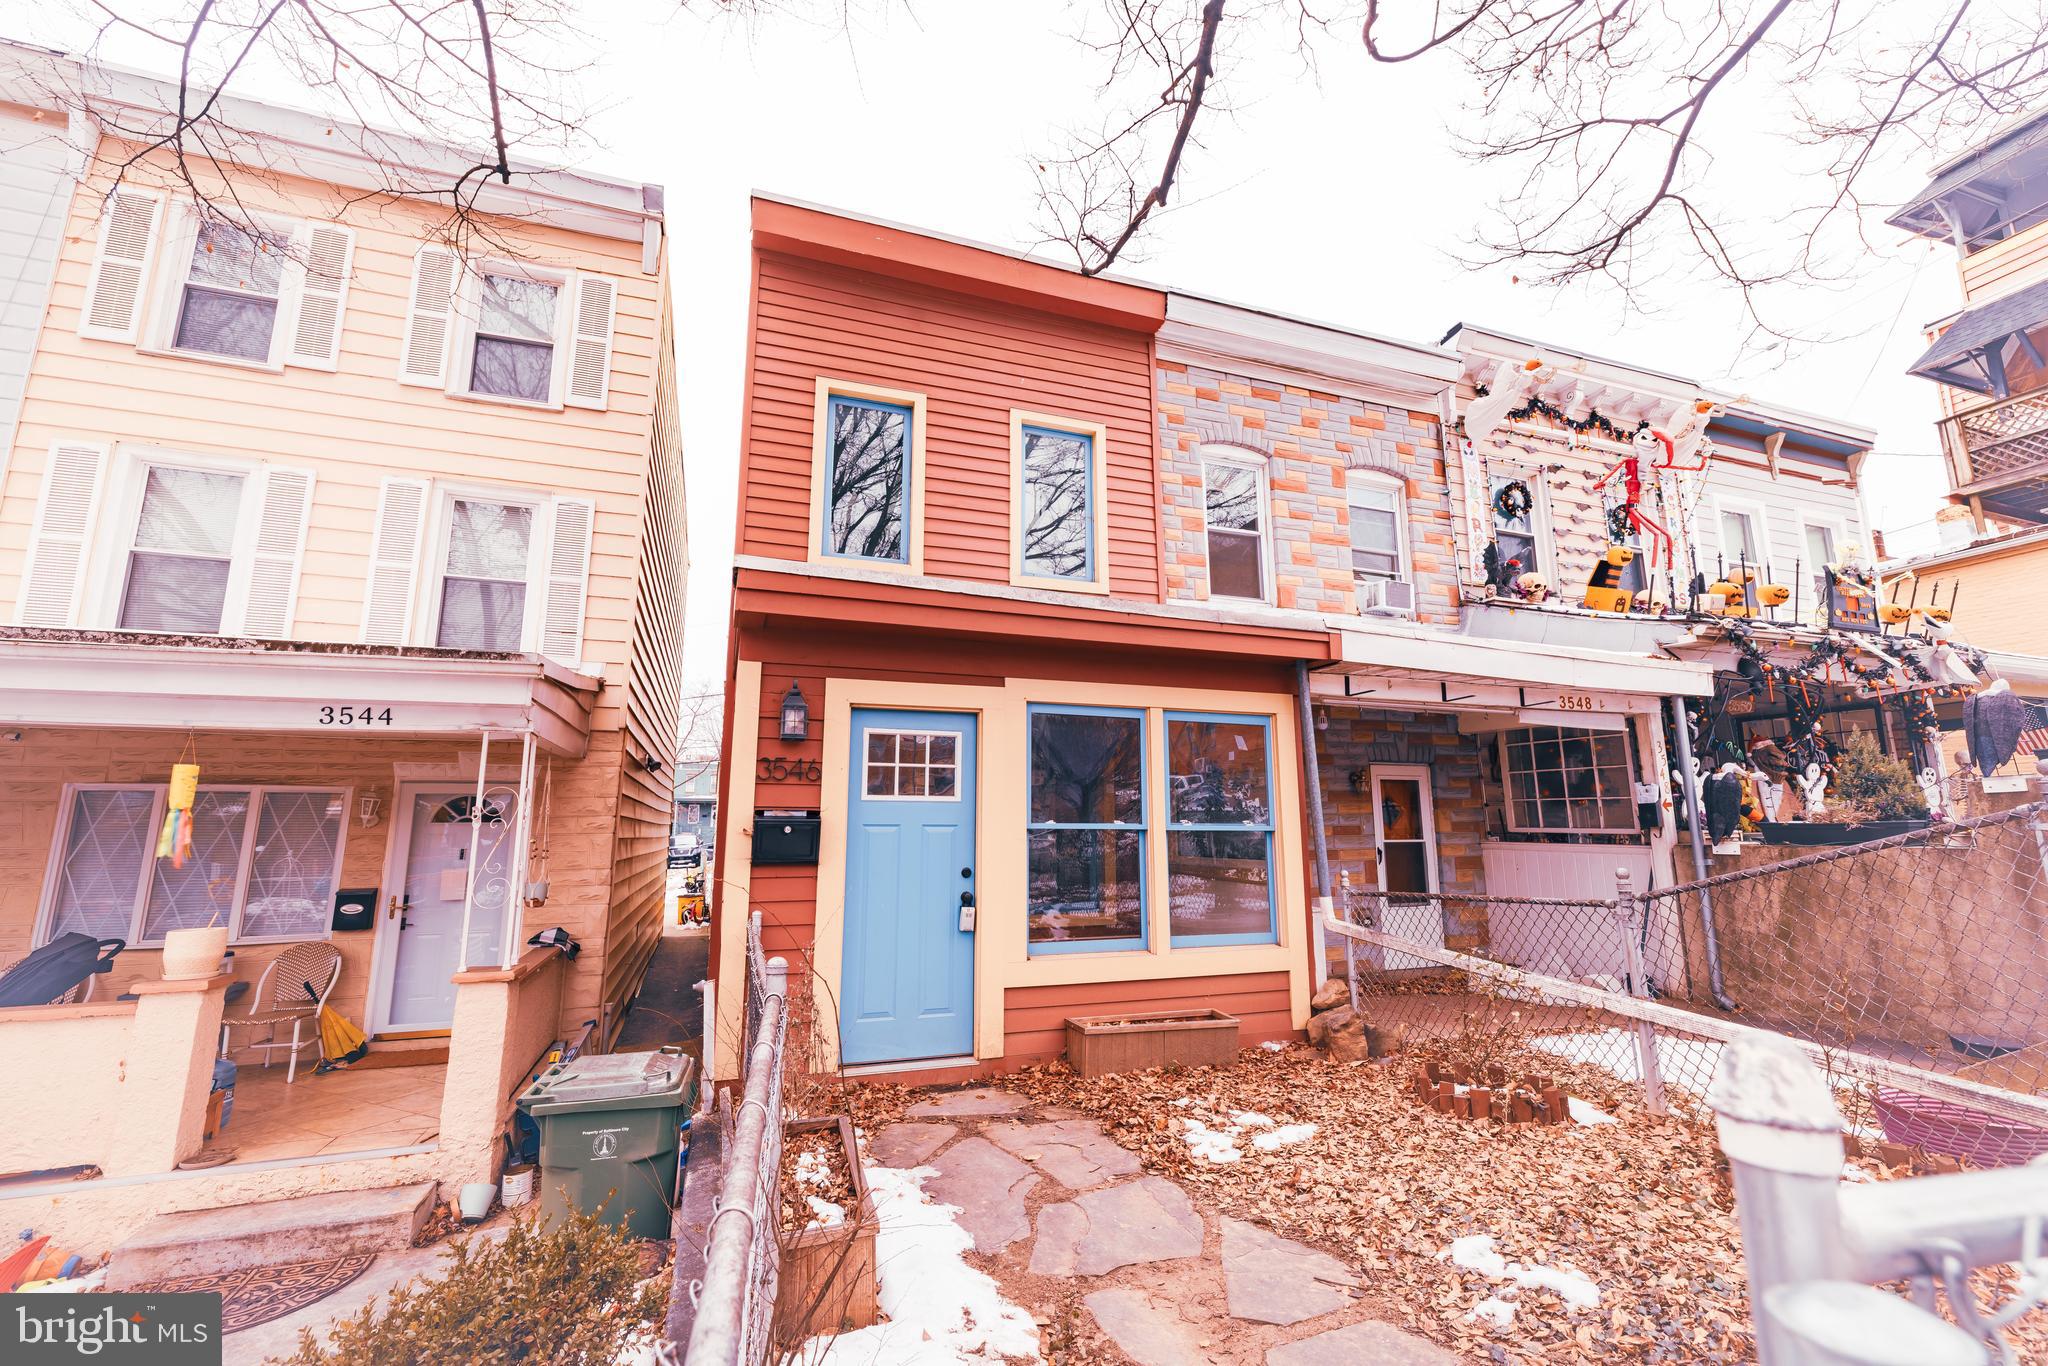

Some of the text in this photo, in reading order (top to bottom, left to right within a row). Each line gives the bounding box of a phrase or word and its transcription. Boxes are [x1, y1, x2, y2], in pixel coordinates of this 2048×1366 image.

[1559, 695, 1592, 710] 3548
[319, 706, 393, 726] 3544
[757, 757, 821, 781] 3546
